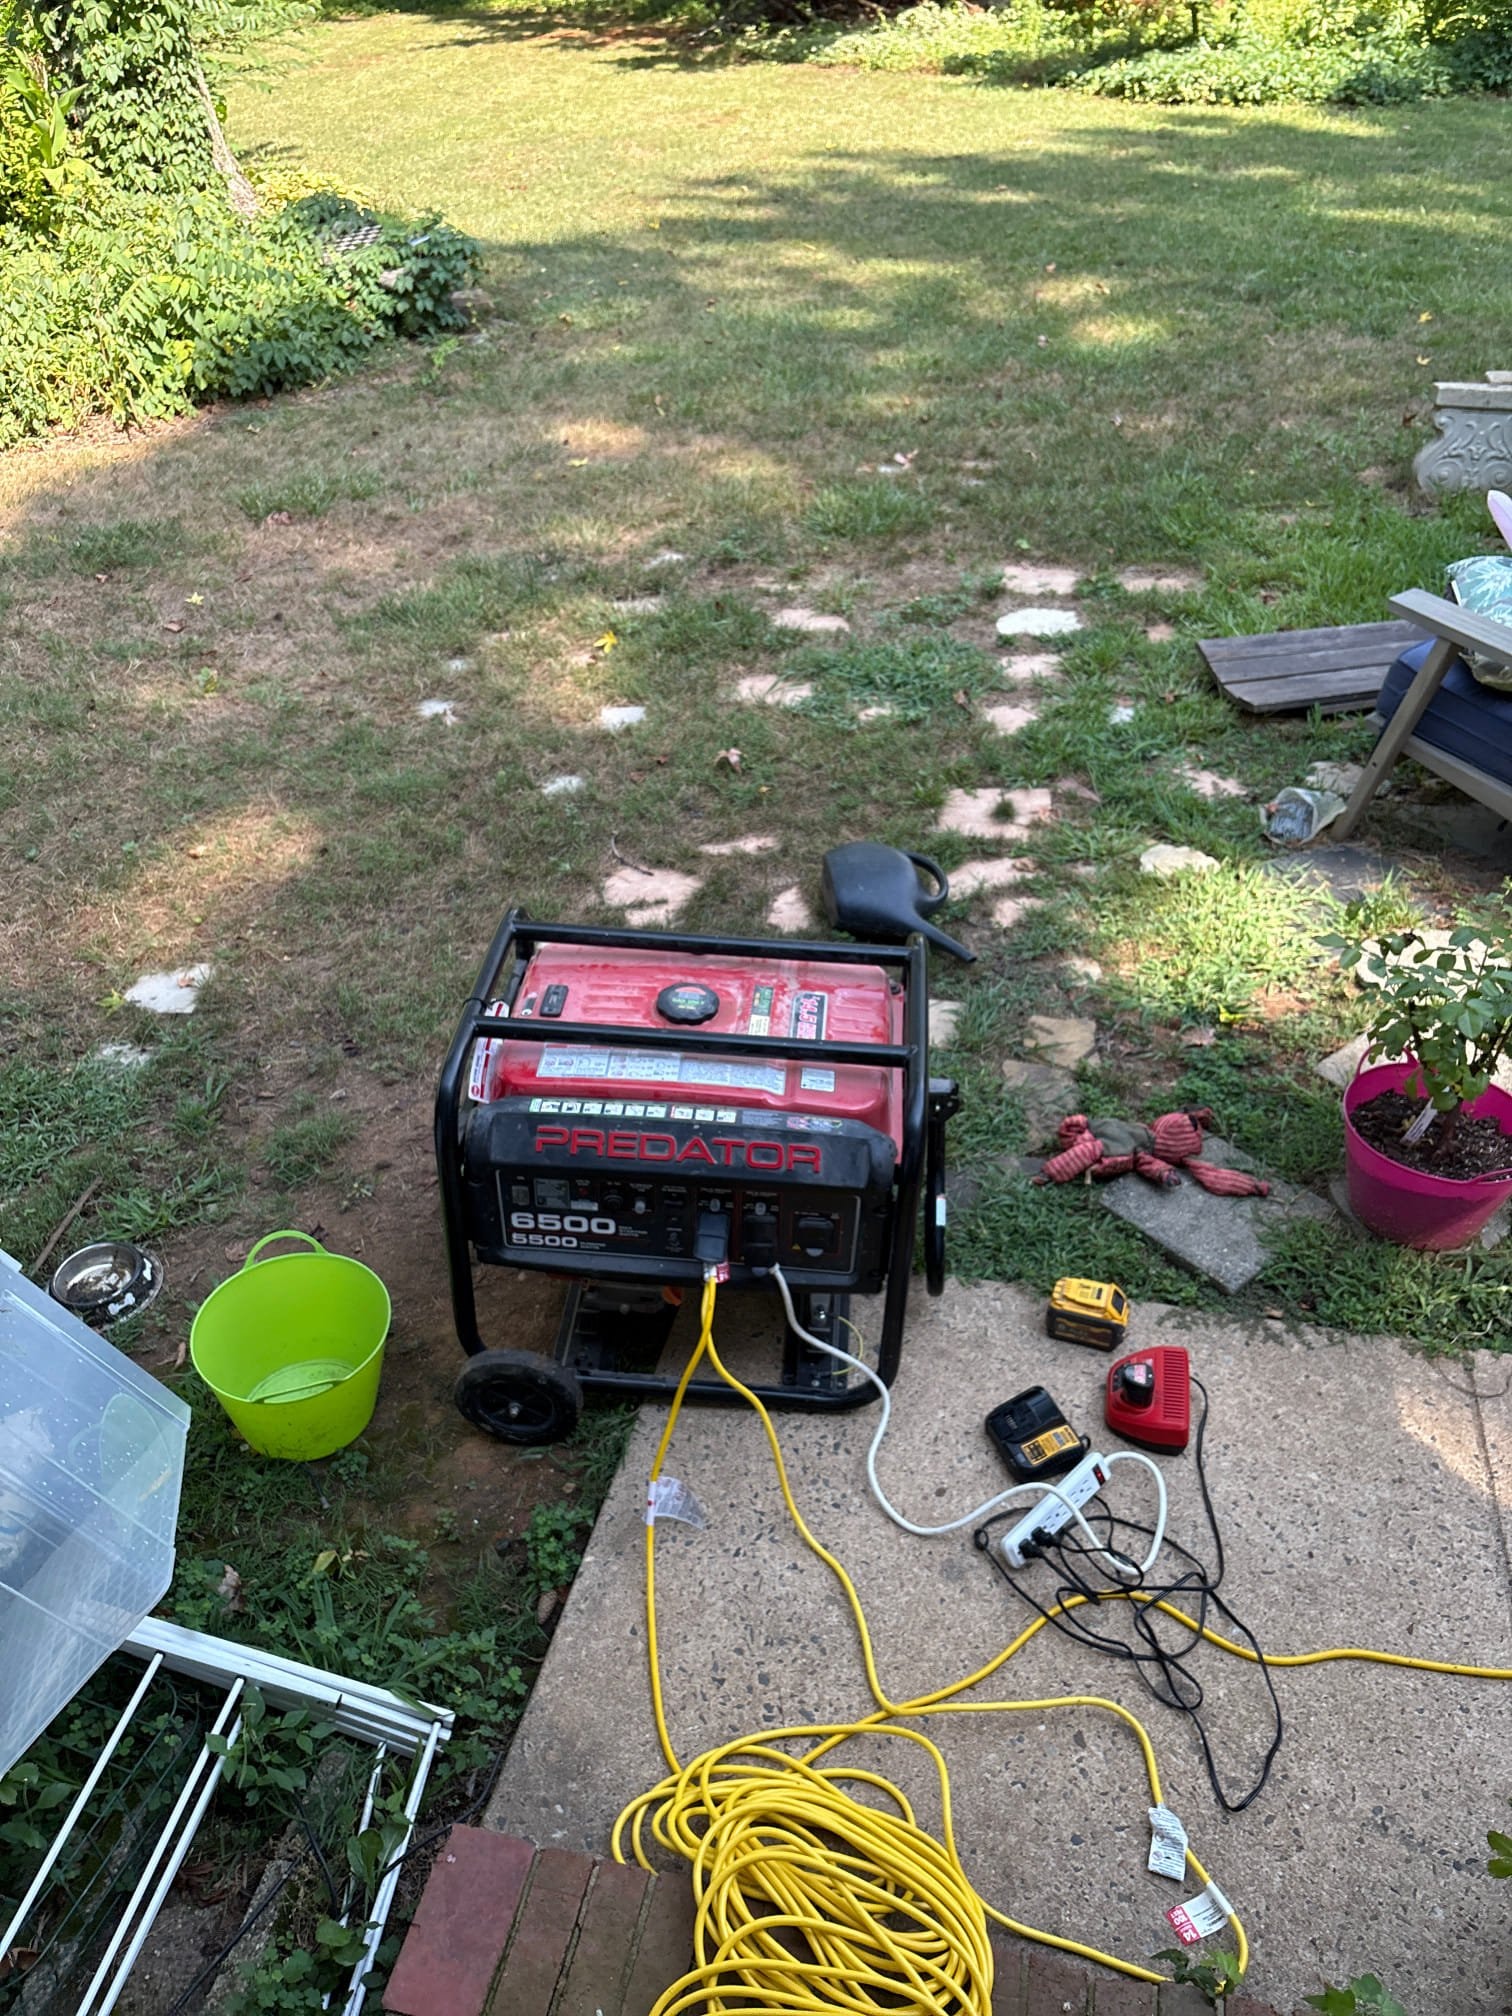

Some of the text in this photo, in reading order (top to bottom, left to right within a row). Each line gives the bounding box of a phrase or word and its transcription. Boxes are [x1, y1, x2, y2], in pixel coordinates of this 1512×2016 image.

[799, 998, 818, 1024] 14.5
[535, 1125, 822, 1173] PREDATOR
[510, 1211, 616, 1235] 6500
[511, 1232, 578, 1248] 5500
[1182, 1928, 1198, 1942] 14
